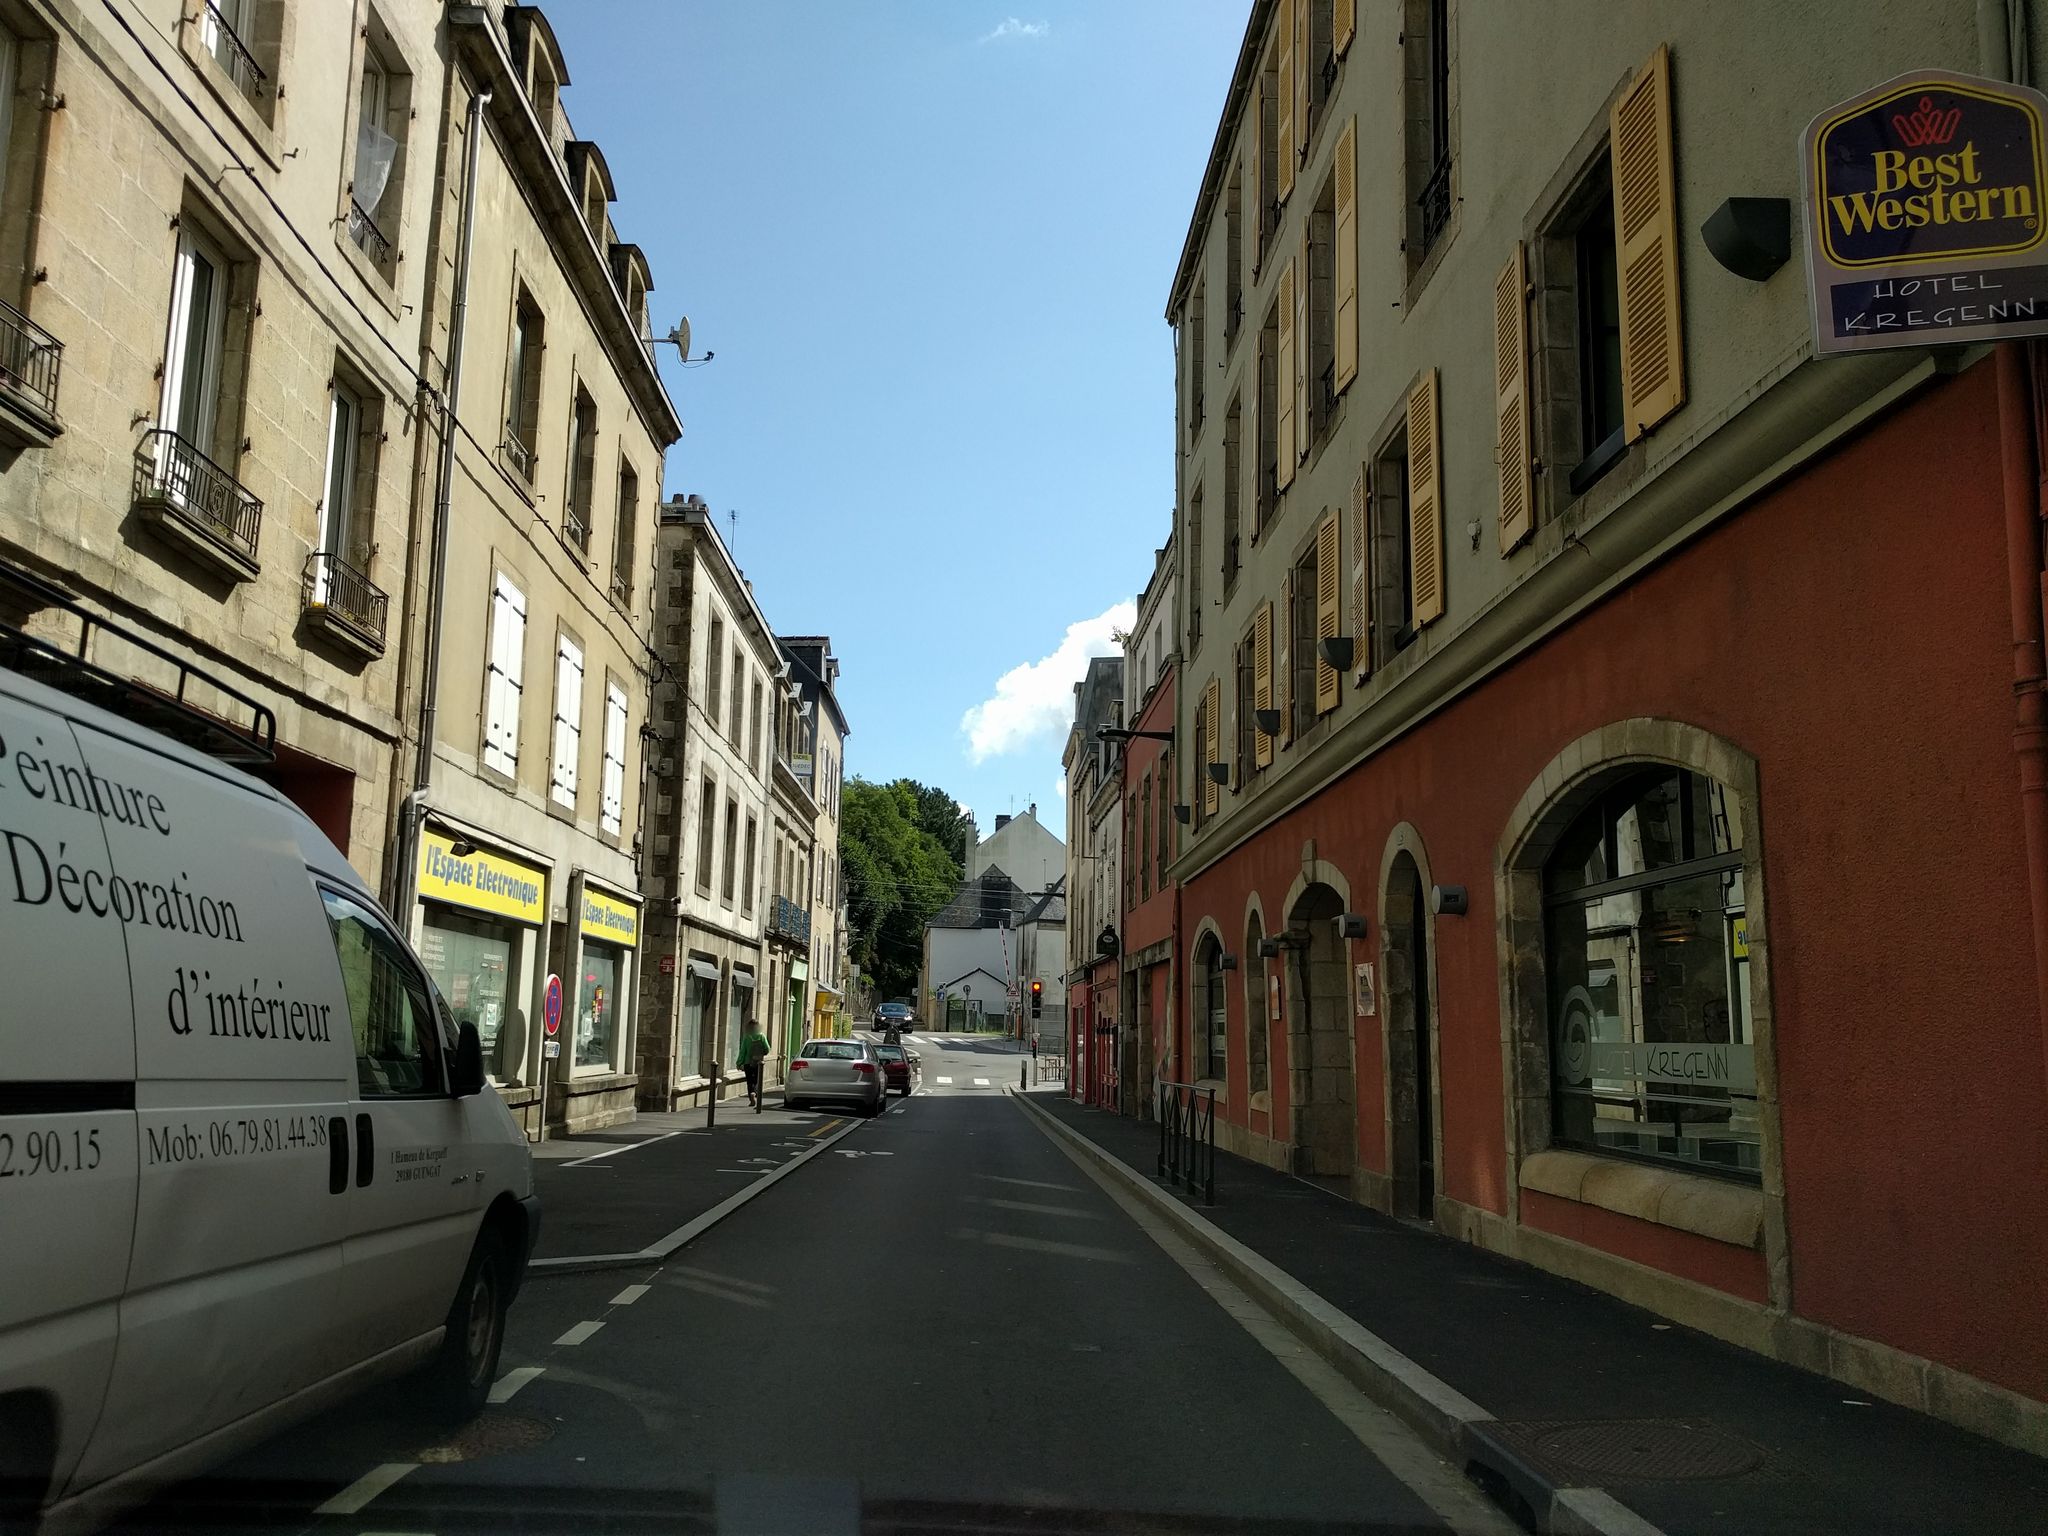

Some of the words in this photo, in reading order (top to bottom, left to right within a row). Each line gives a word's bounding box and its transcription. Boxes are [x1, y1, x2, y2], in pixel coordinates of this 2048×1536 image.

[1870, 140, 1982, 194] Best
[1828, 176, 2035, 236] Western
[1845, 297, 2035, 331] KREGENN
[1873, 275, 2002, 299] HOTEL
[0, 734, 171, 836] einture
[0, 829, 246, 942] Décoration
[426, 844, 474, 887] l'Espace
[476, 861, 539, 908] Electronique
[1646, 1045, 1729, 1086] KREGENN
[147, 1123, 204, 1165] Mob:
[209, 1115, 327, 1159] 06.79.81.44.38
